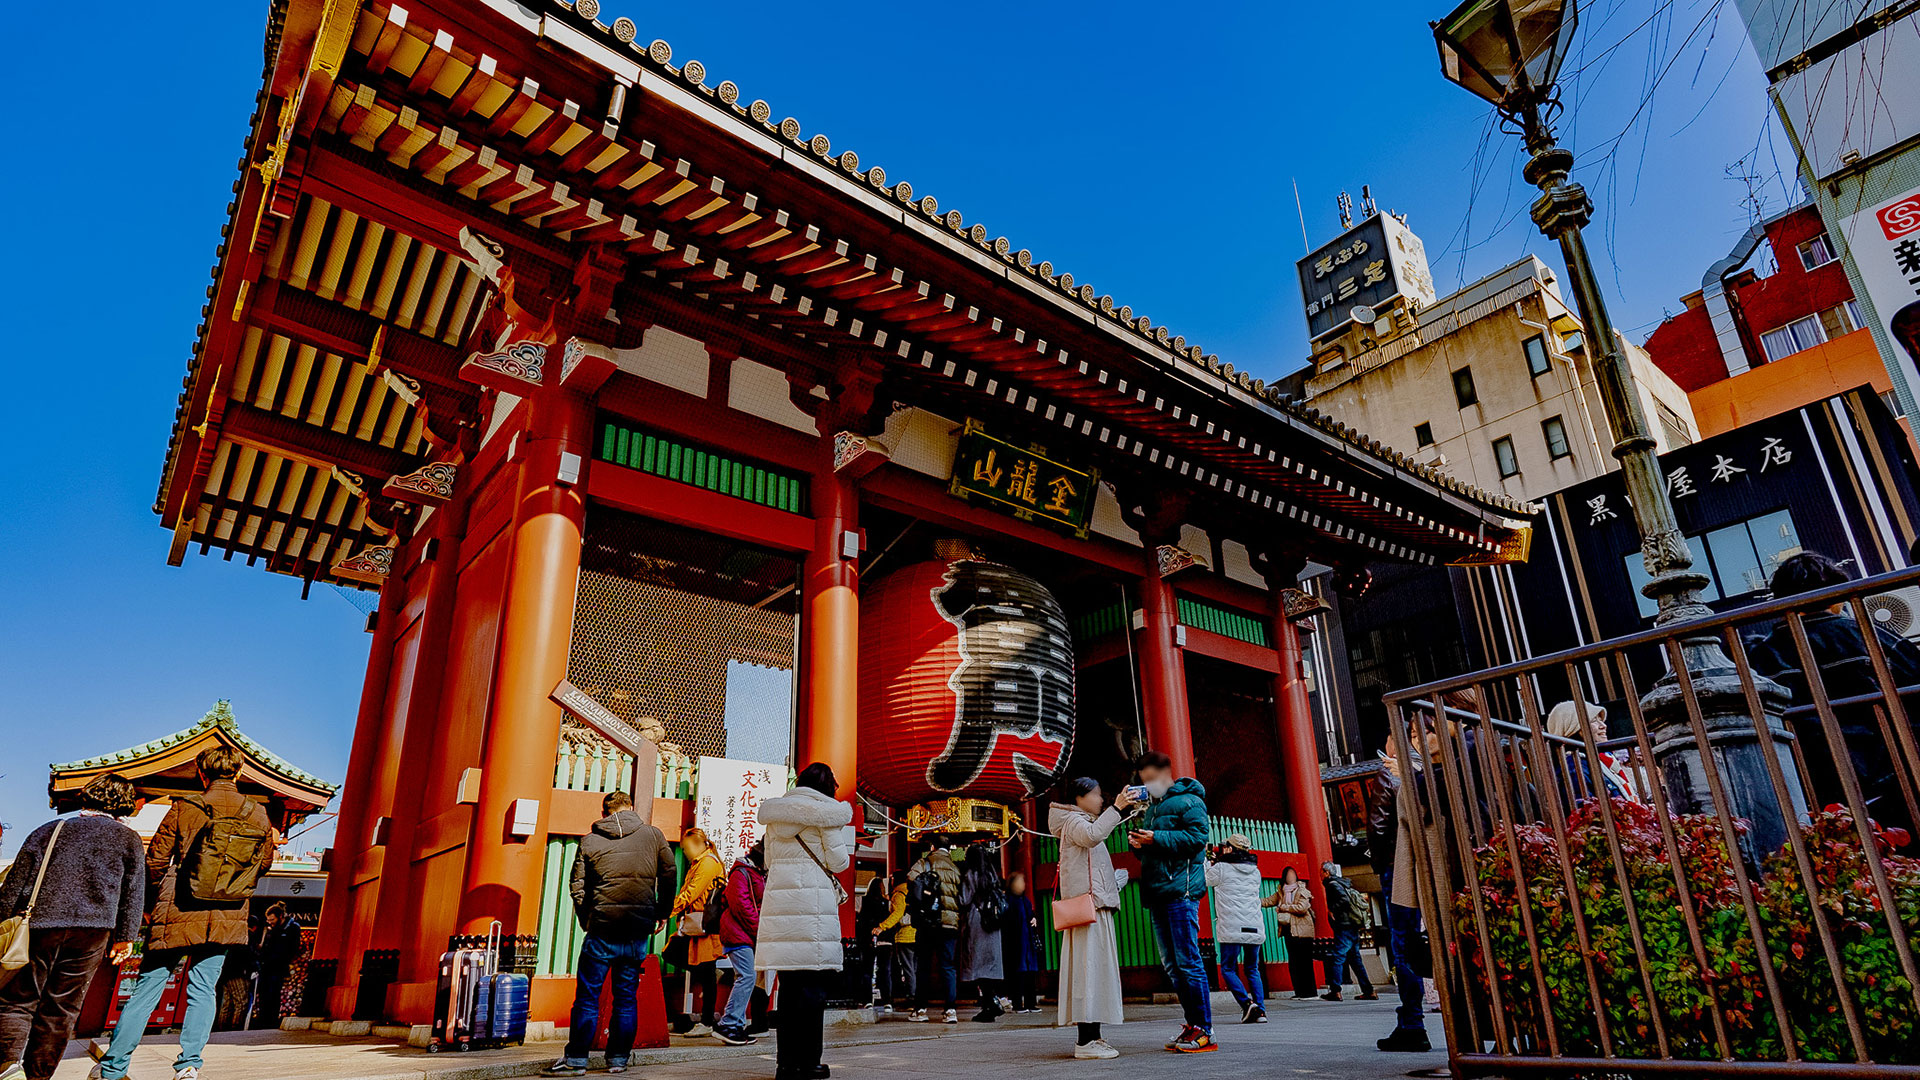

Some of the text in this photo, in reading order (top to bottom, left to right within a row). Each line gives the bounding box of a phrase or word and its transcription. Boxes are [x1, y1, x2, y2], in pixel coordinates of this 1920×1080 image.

[1314, 239, 1368, 279] 天ぷら
[1338, 259, 1387, 301] 三定
[1586, 437, 1793, 526] 黒屋本店
[569, 690, 622, 731] KAMINARIMON
[621, 727, 642, 745] GATE
[723, 795, 737, 874] 著名文化芸能
[738, 770, 758, 855] 文化芸能
